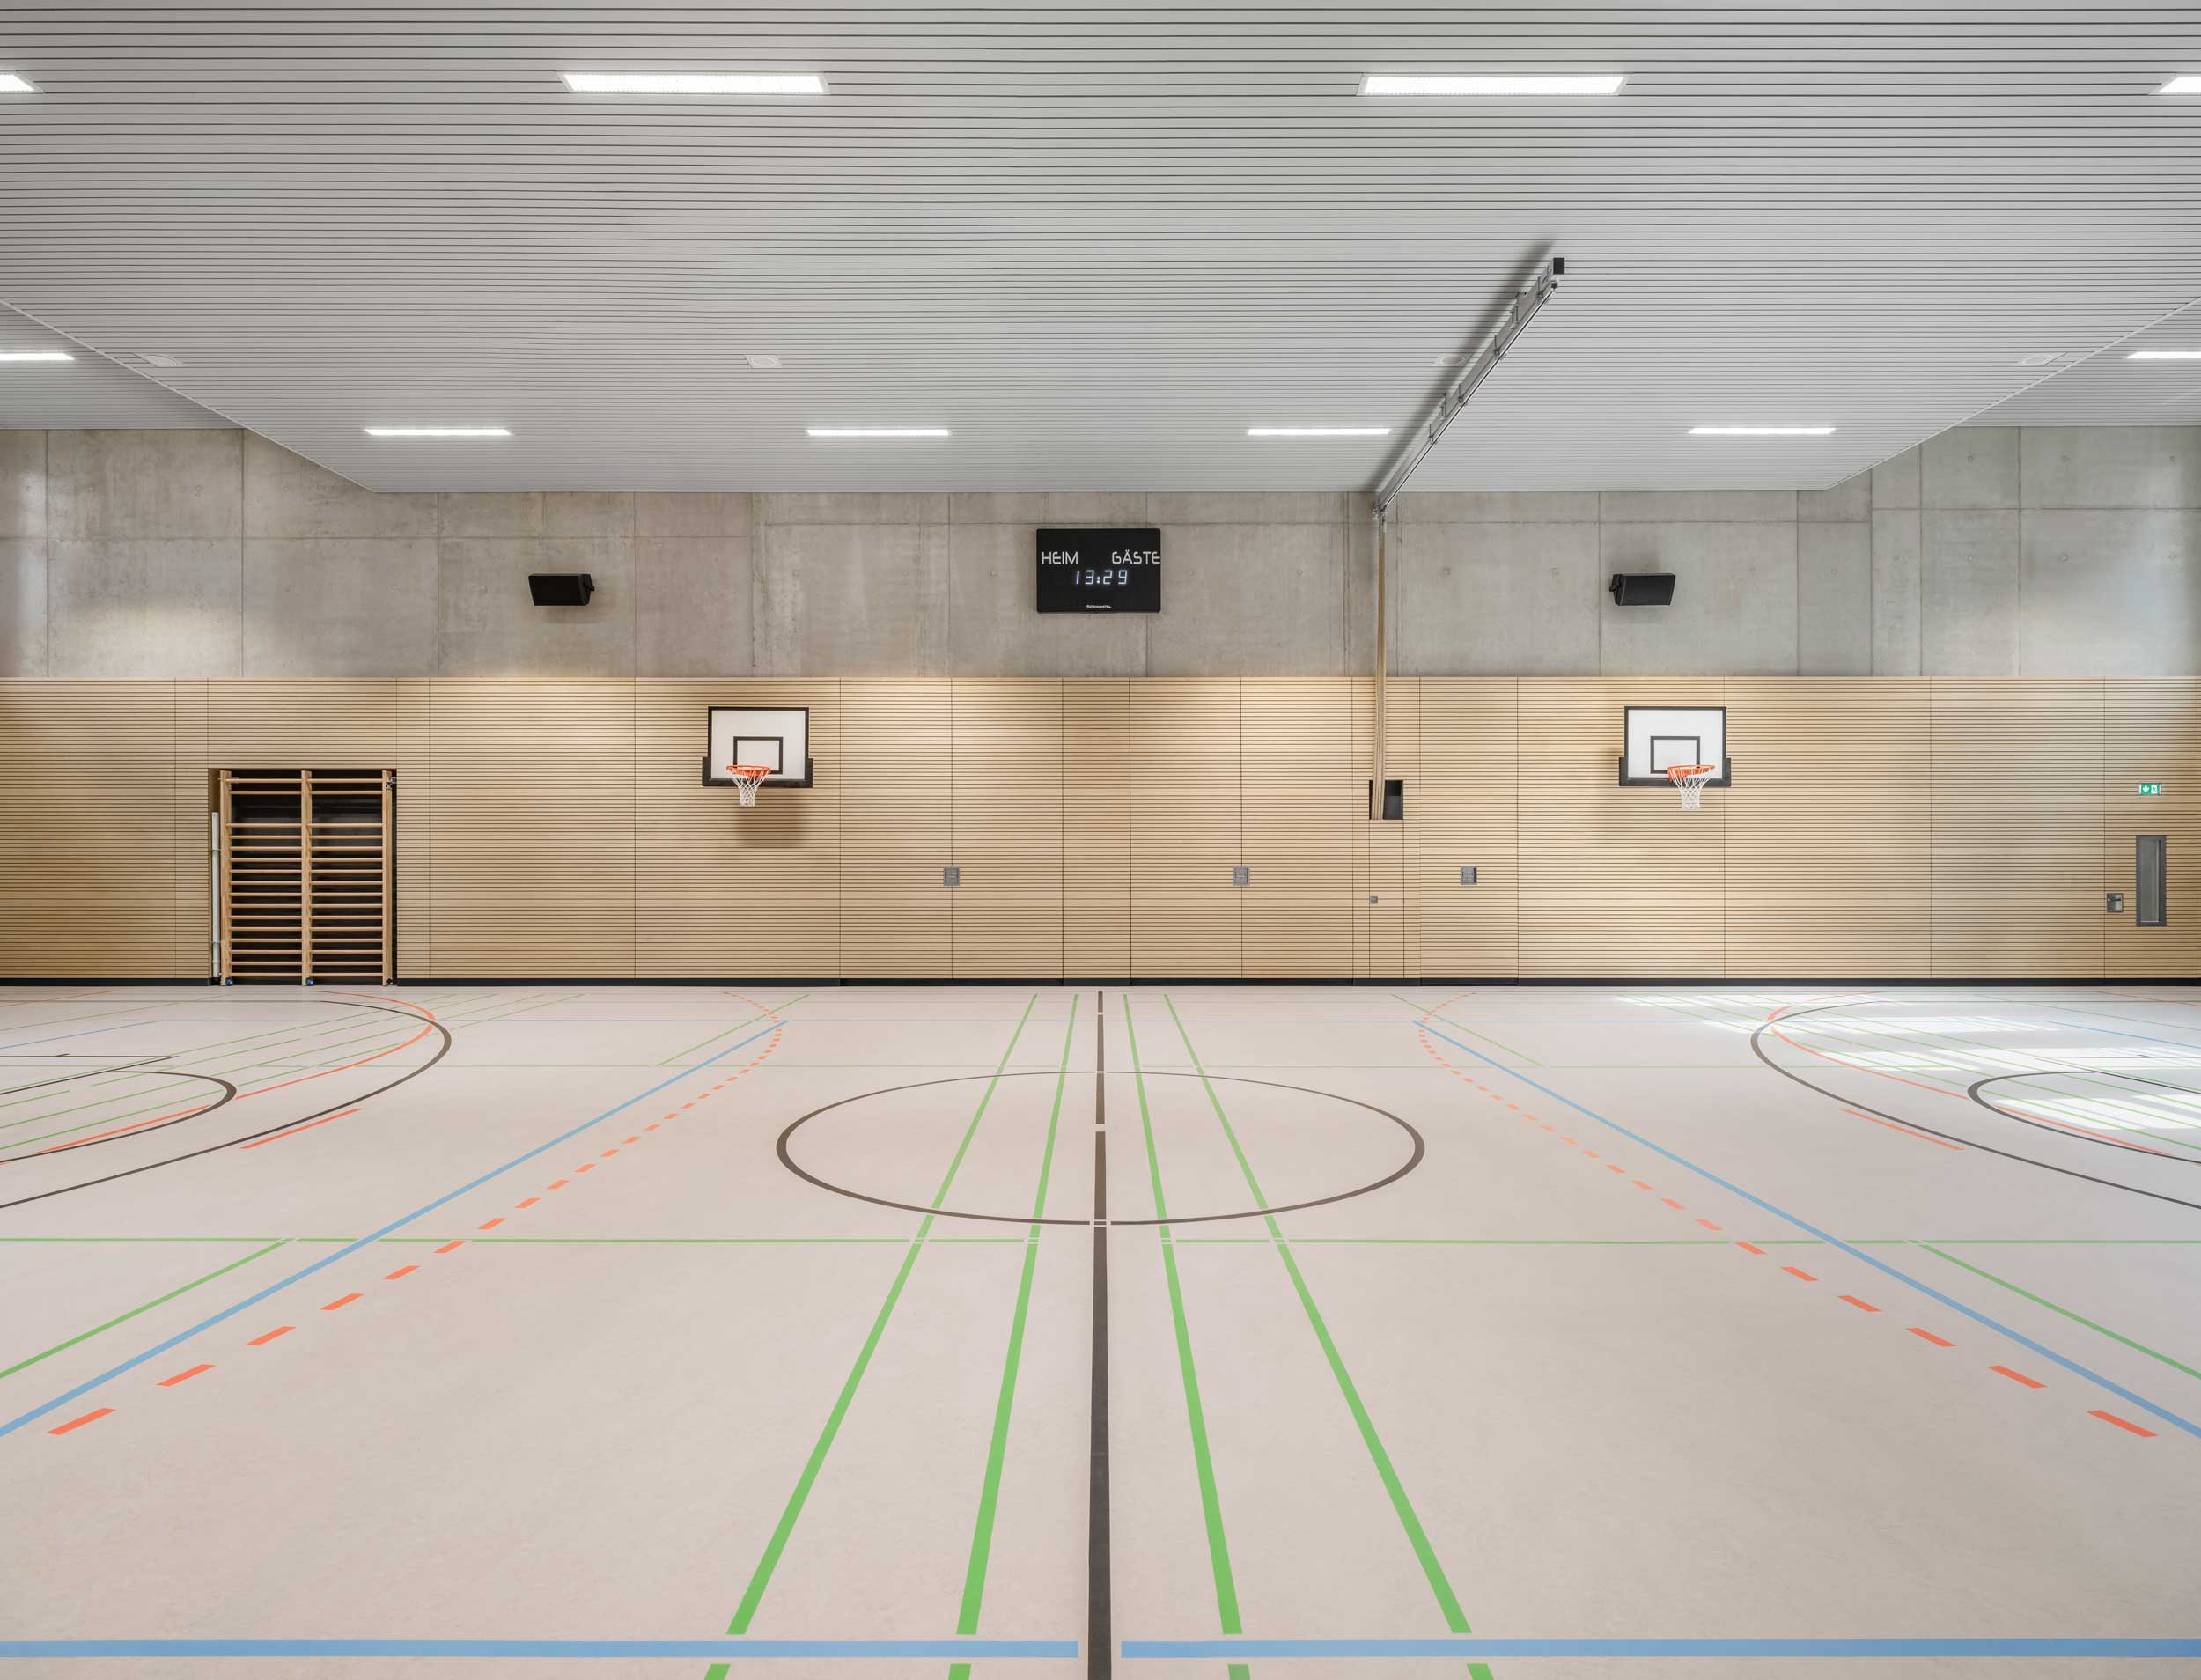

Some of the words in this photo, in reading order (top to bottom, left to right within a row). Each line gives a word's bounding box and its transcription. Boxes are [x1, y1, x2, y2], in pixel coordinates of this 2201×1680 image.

[1042, 551, 1078, 565] HEIM
[1111, 549, 1160, 564] GÄSTE
[1075, 570, 1128, 585] 13:29
